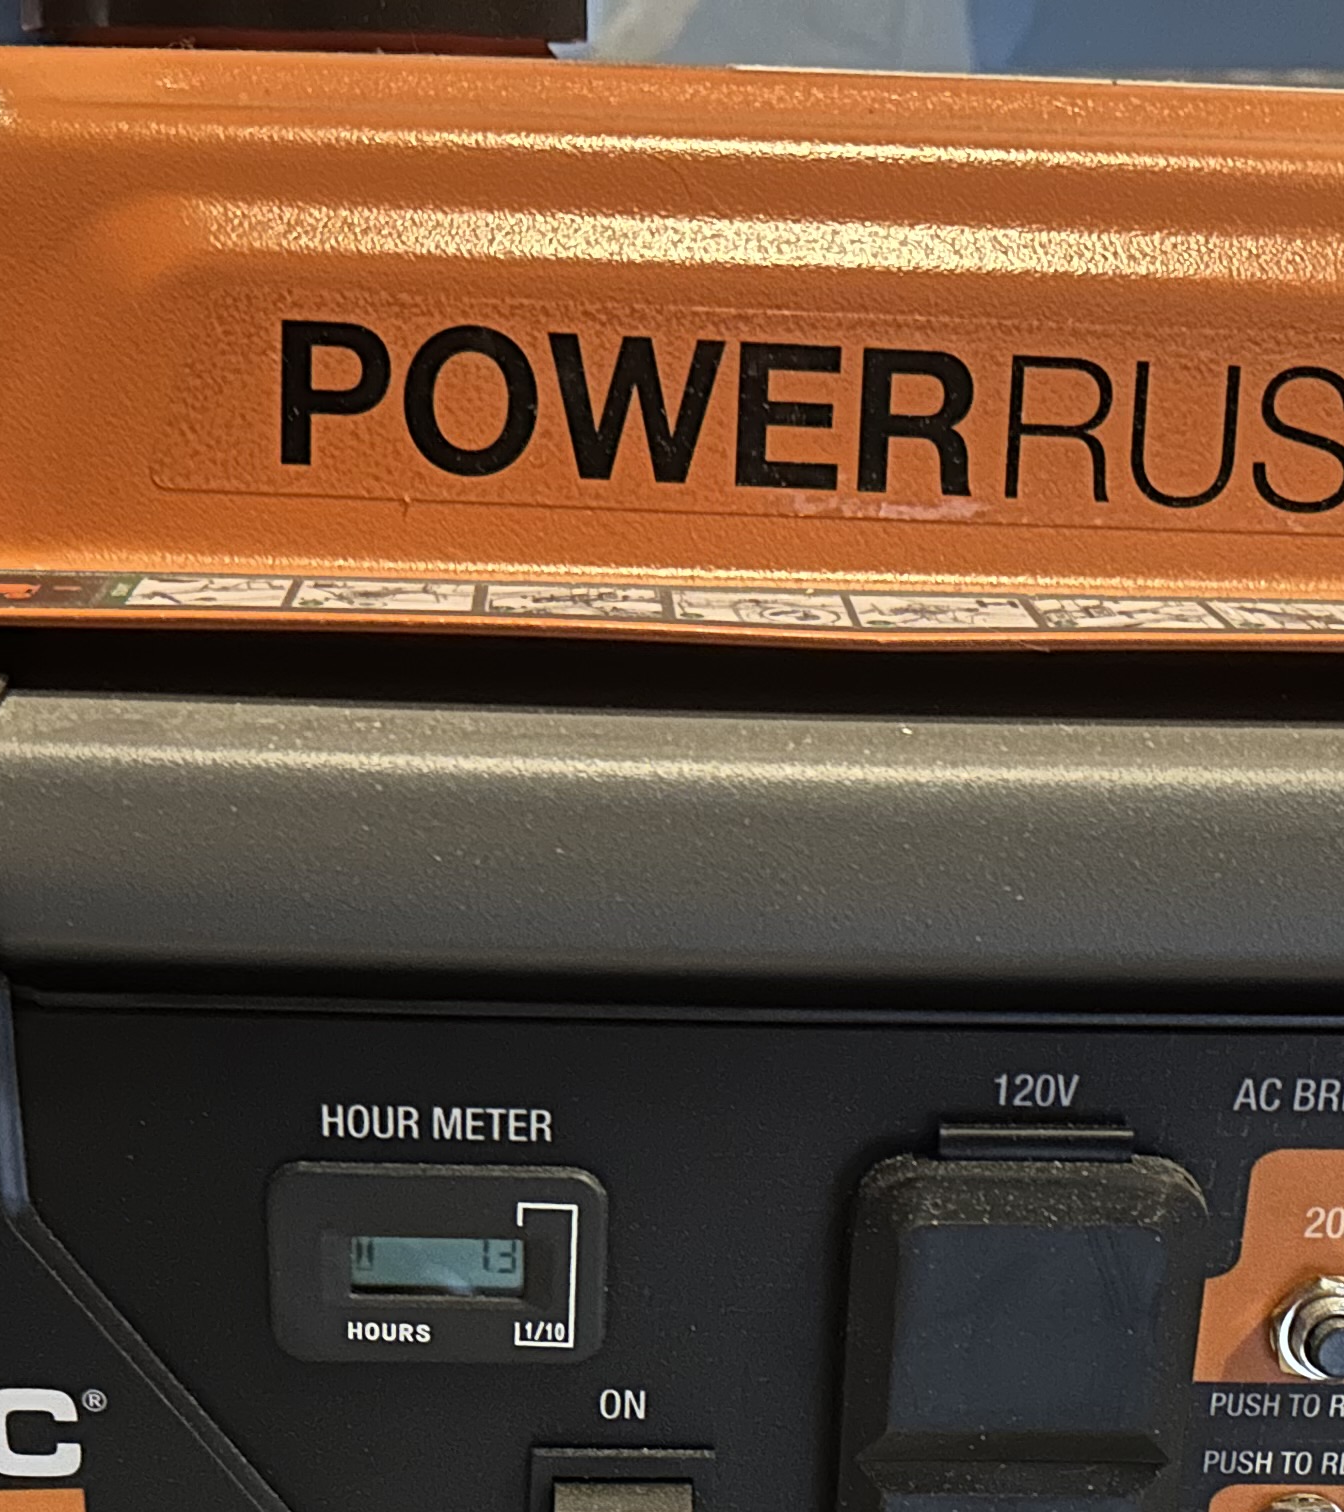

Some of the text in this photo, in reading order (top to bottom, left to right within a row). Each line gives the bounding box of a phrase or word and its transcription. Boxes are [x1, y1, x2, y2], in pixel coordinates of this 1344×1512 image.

[994, 1073, 1080, 1107] 120V
[1233, 1077, 1283, 1112] AC
[321, 1104, 552, 1142] HOUR METER
[347, 1321, 431, 1343] HOURS
[524, 1321, 565, 1341] 1/10
[599, 1389, 646, 1420] ON
[1210, 1392, 1281, 1417] PUSH
[1288, 1393, 1321, 1418] TO
[1203, 1450, 1273, 1474] PUSH
[1280, 1451, 1313, 1476] TO
